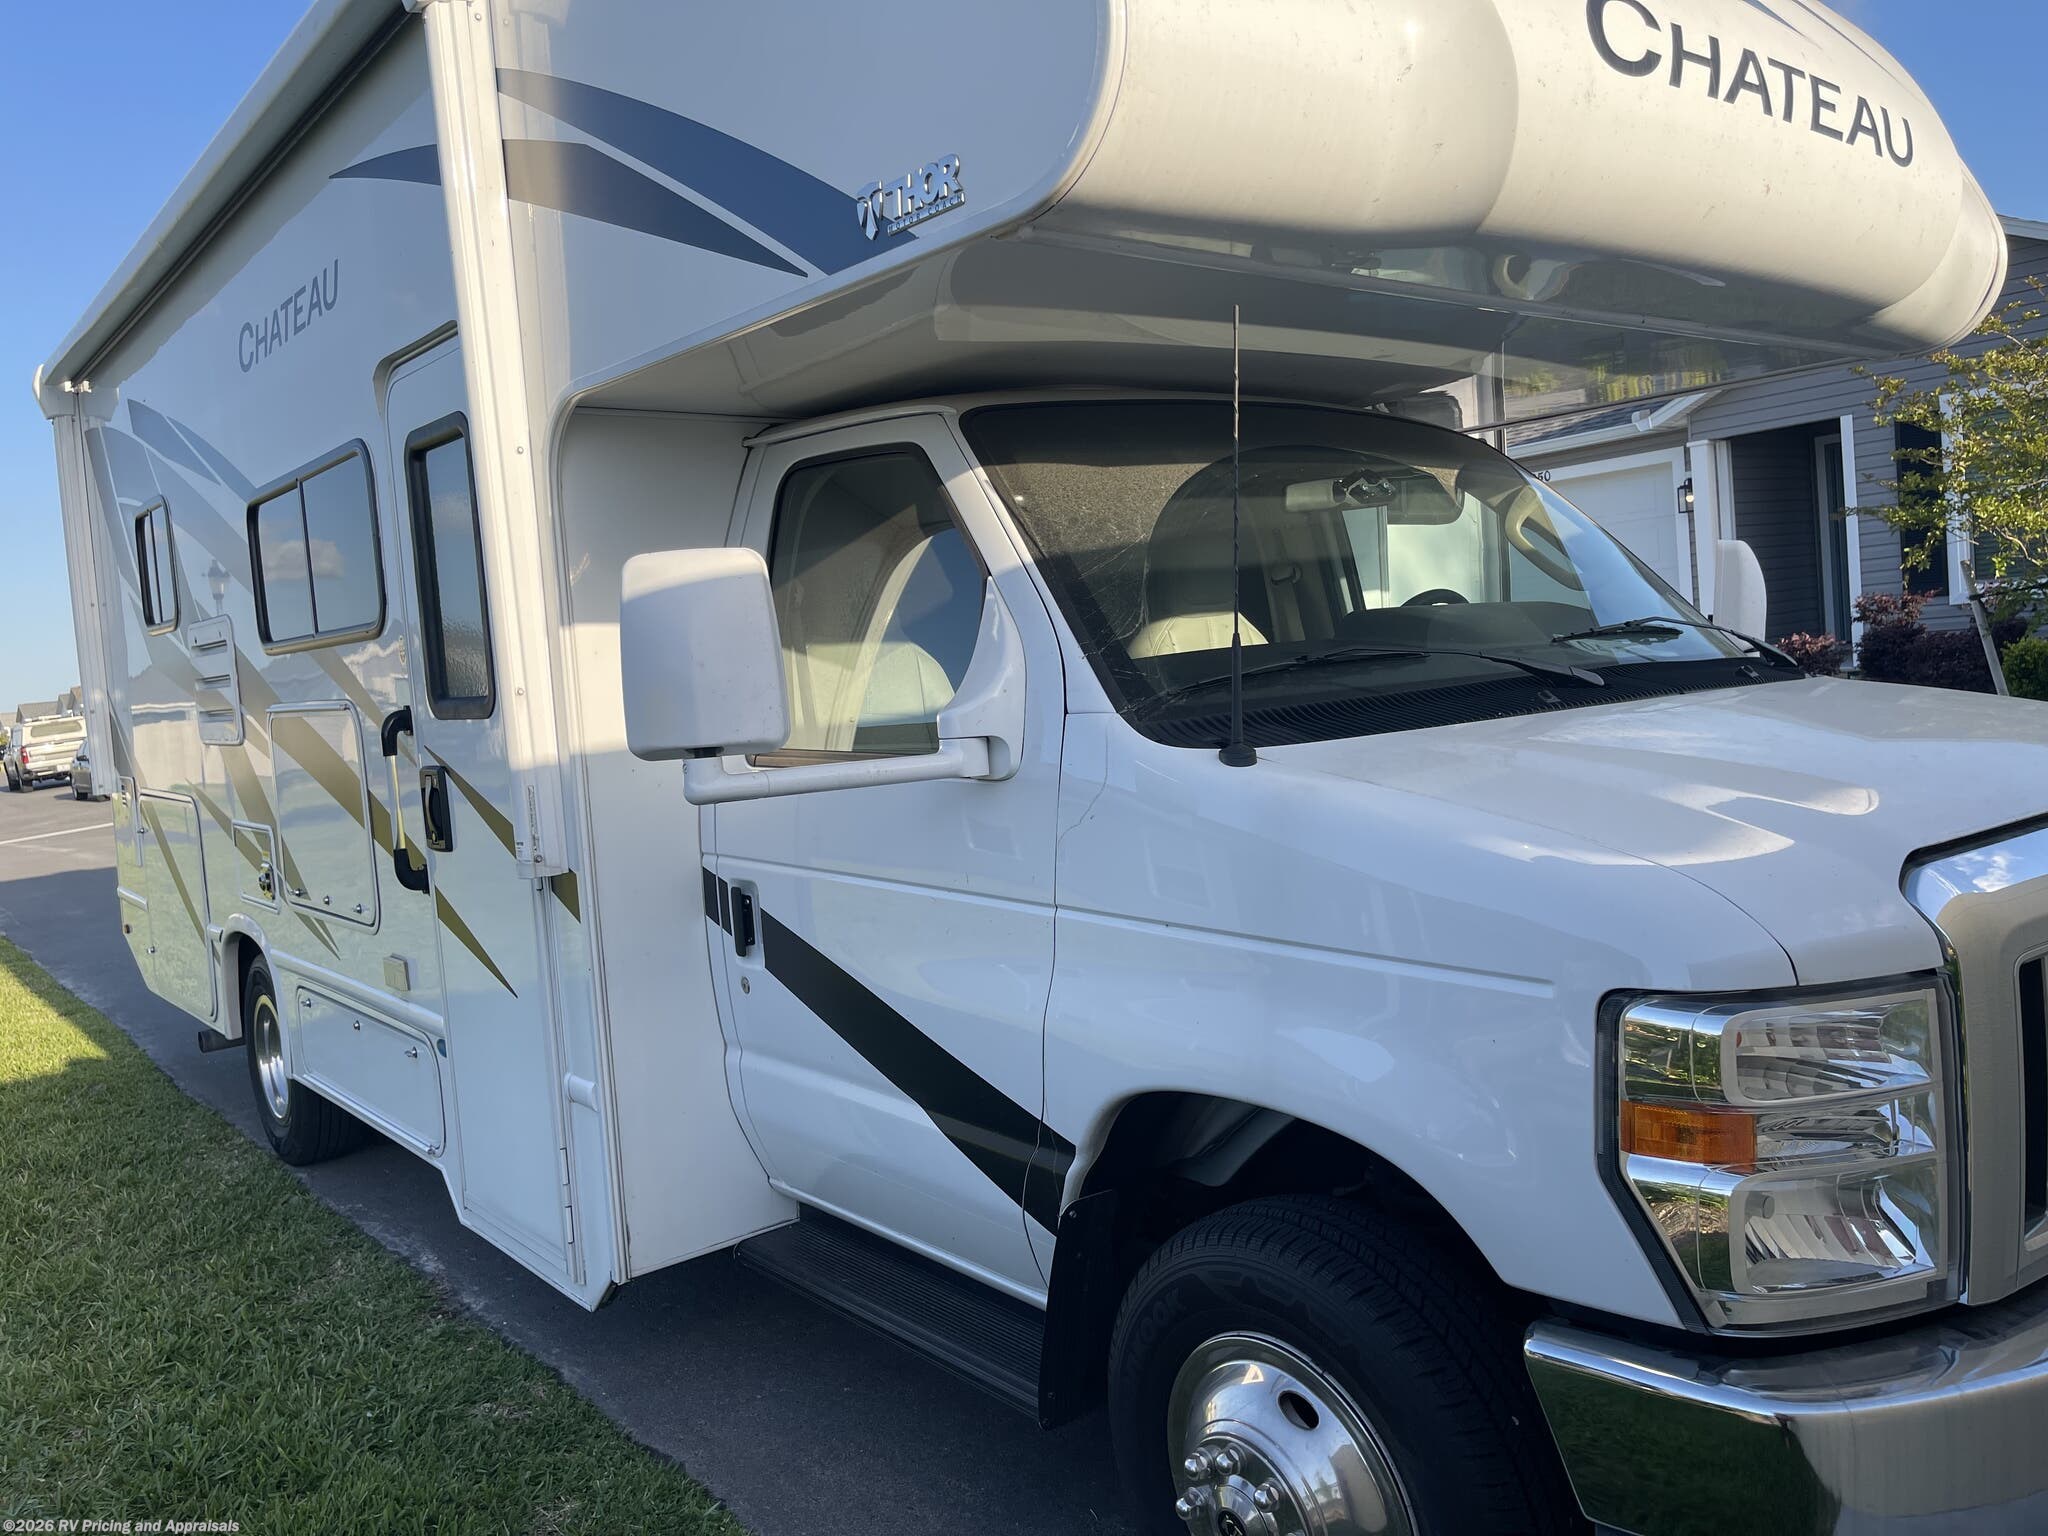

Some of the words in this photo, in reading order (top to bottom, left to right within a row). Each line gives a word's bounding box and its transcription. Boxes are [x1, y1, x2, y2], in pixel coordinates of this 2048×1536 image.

[1585, 0, 1914, 168] CHATEAU
[884, 153, 964, 221] THOR
[888, 213, 921, 232] MOTOR
[927, 194, 962, 216] COACH
[238, 258, 339, 373] CHATEAU
